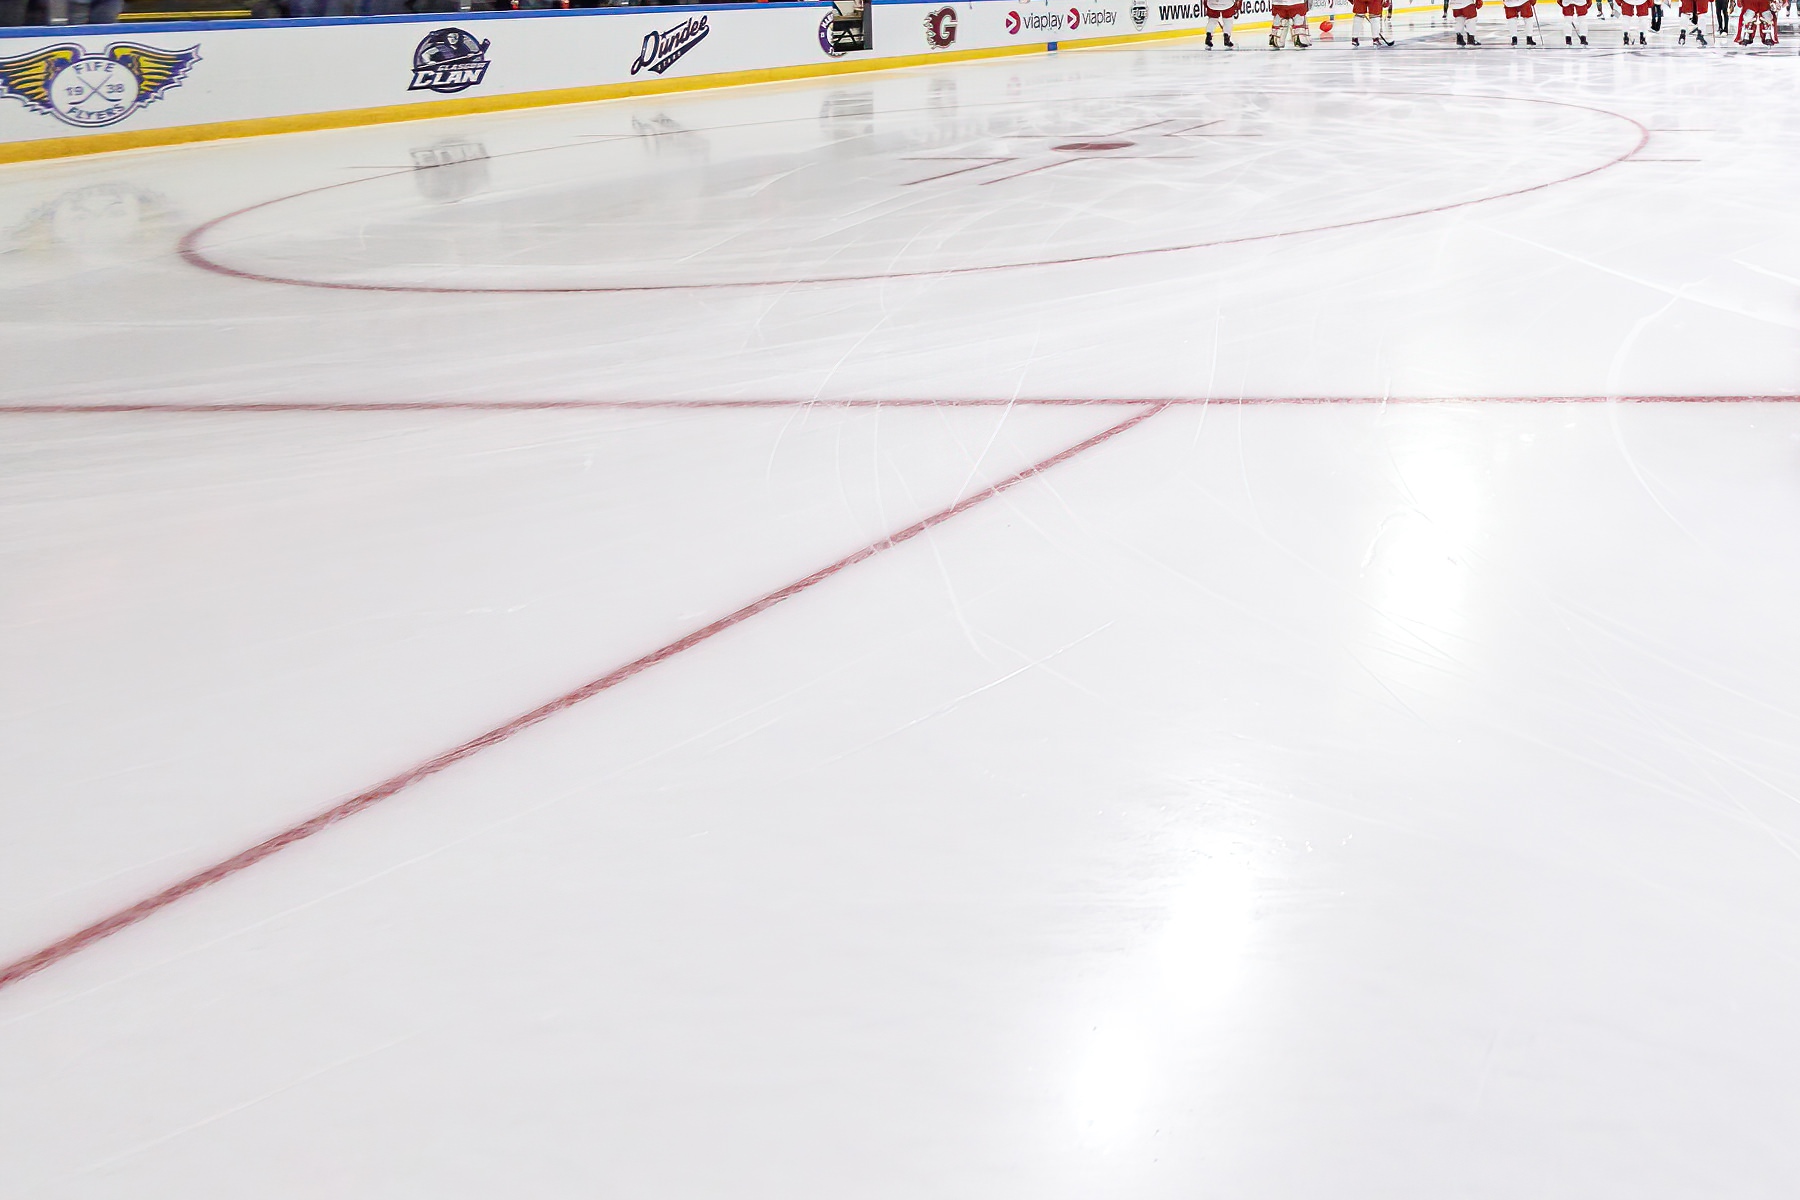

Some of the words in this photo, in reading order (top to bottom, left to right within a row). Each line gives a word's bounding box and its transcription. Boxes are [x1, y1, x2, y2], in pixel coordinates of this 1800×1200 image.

[1022, 10, 1064, 31] viaplay
[1081, 6, 1117, 27] viaplay
[631, 15, 710, 75] Dundee
[72, 62, 117, 74] FIFE
[436, 61, 486, 72] GLASGOW
[414, 69, 483, 87] CLAN
[65, 86, 84, 96] 19
[105, 83, 125, 94] 38
[66, 103, 126, 120] FLYERS
